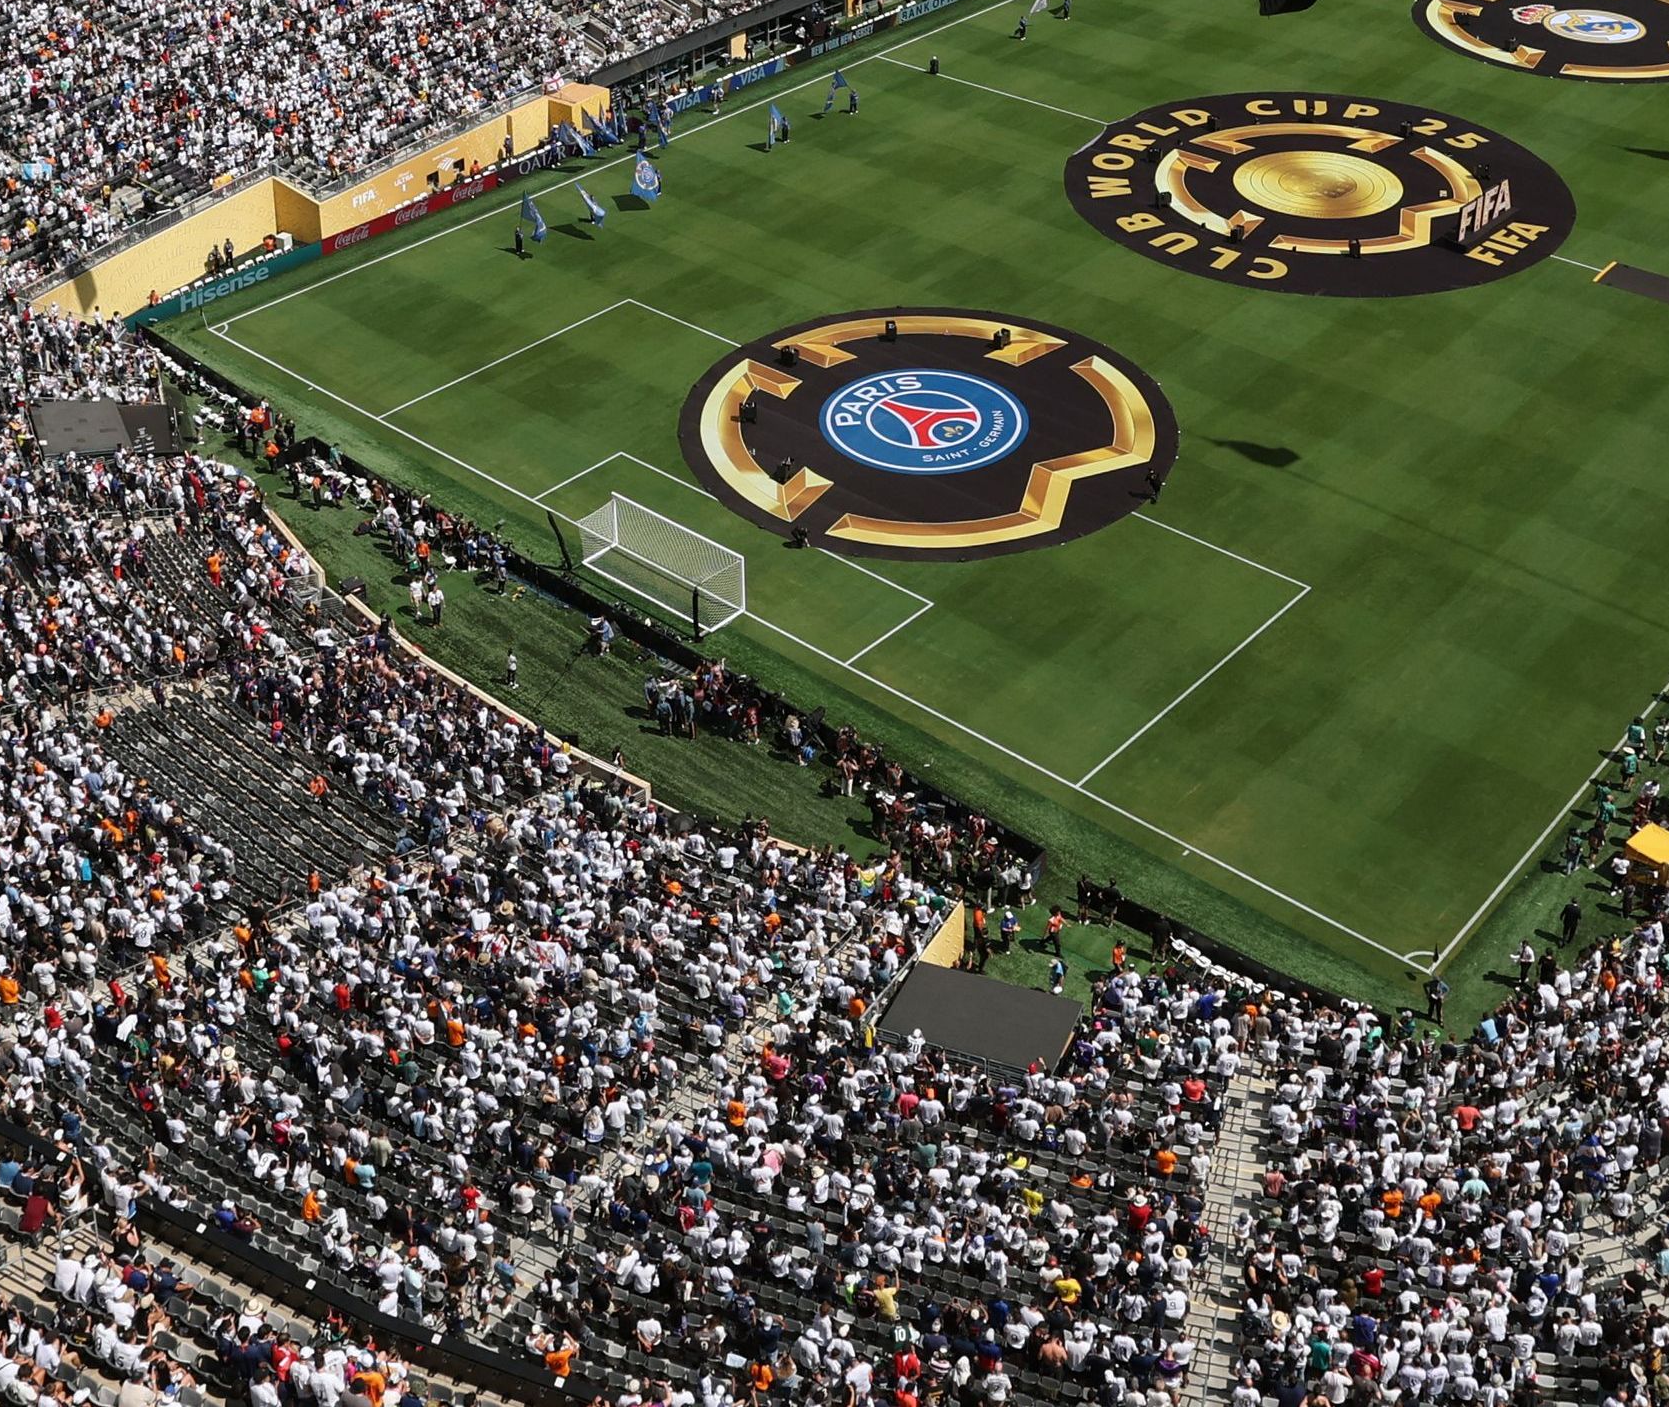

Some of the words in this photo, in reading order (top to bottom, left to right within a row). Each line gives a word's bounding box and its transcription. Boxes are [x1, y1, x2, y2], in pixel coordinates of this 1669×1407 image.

[901, 0, 931, 21] BANK
[853, 23, 874, 40] JERSEY
[740, 66, 766, 86] VISA
[674, 92, 701, 112] VISA
[1245, 98, 1380, 120] CUP
[1413, 117, 1490, 150] 25
[519, 144, 566, 175] QATAR
[1090, 108, 1212, 198] WORLD
[352, 188, 377, 208] FIFA
[451, 179, 484, 203] Coca-Cola
[394, 201, 428, 226] Coca-Cola
[1458, 178, 1511, 243] FIFA
[334, 223, 370, 250] Coca-Cola
[1116, 211, 1289, 280] CLUB
[1463, 221, 1550, 267] FIFA
[179, 266, 270, 313] Hisense
[834, 376, 922, 427] PARIS
[922, 448, 970, 463] SAINT
[979, 410, 1005, 448] GERMAIN
[894, 1329, 908, 1342] 10
